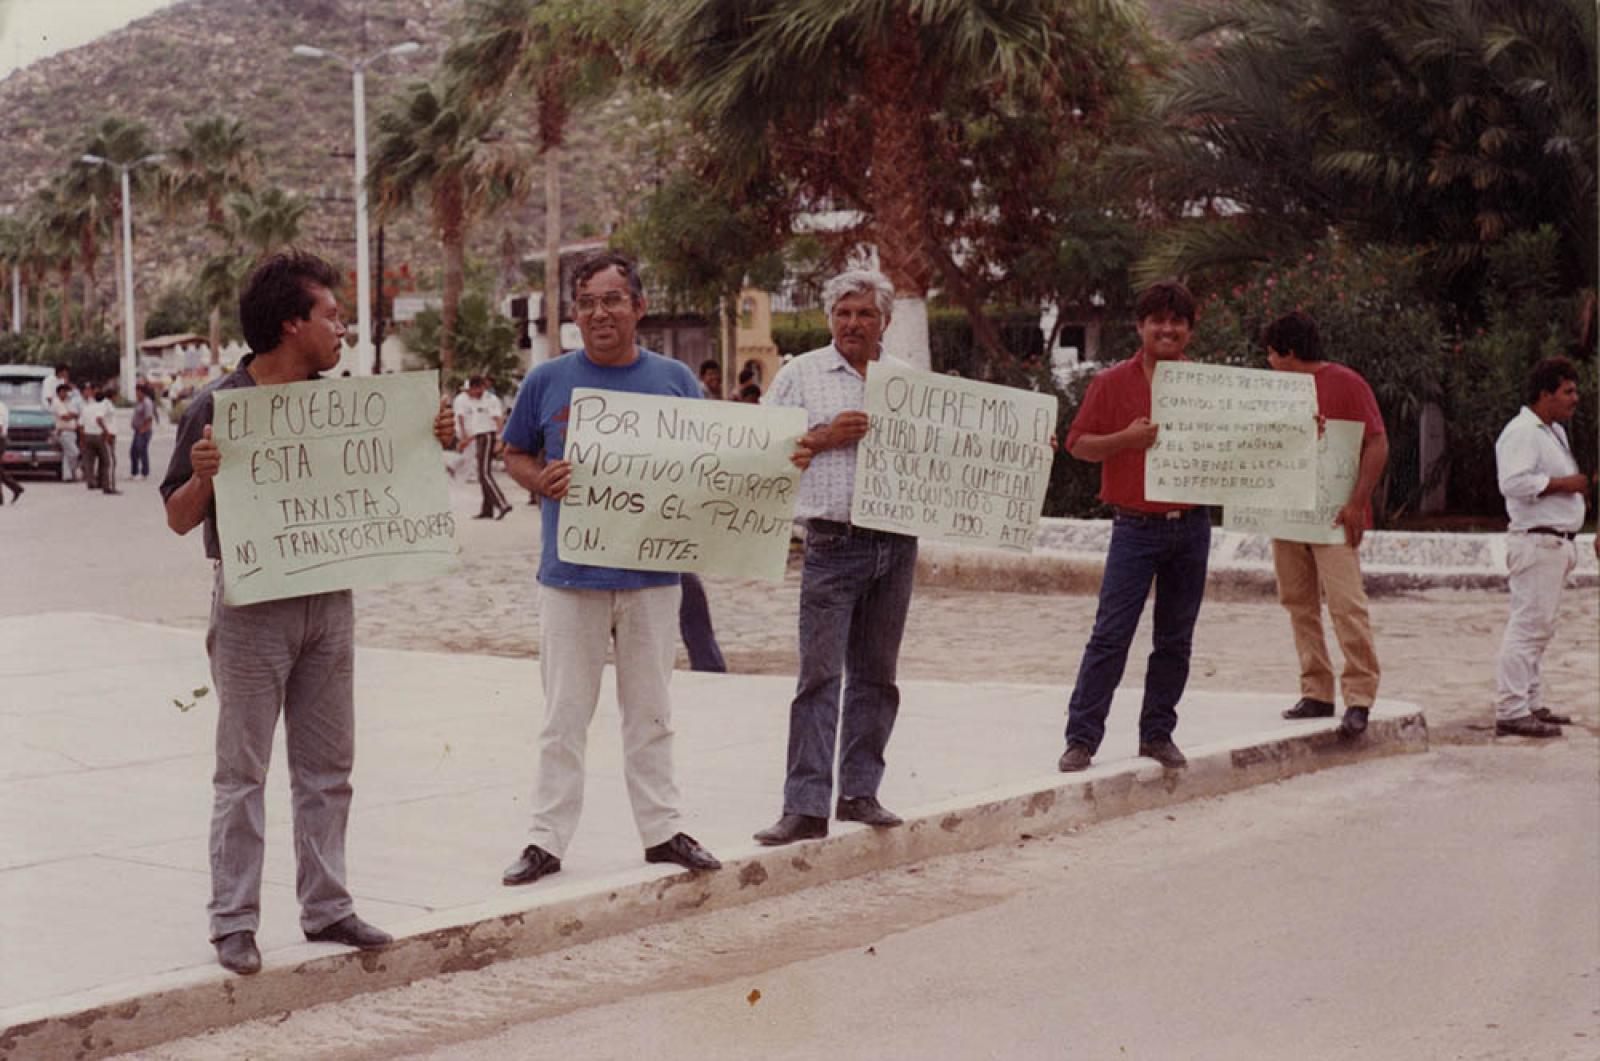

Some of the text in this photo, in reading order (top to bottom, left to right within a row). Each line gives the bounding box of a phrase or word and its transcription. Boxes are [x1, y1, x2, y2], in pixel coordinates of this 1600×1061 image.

[228, 390, 386, 440] EL PUEBLO
[573, 396, 770, 450] POR NINGUN
[885, 376, 1019, 440] QUEREMOS
[867, 414, 917, 453] RETIRO
[924, 427, 942, 453] DE
[952, 431, 982, 459] LAS
[251, 438, 393, 485] ESTA CON
[568, 442, 684, 482] MOTIVO
[865, 450, 887, 473] DES
[929, 459, 949, 482] NO
[962, 464, 1035, 499] CUMPLAN
[1173, 475, 1275, 489] DEFENDERLOS
[279, 486, 400, 525] TAXISTAS
[563, 485, 645, 514] EMOS
[660, 494, 691, 521] EL
[859, 500, 914, 521] DECRETO
[922, 508, 938, 524] DE
[899, 480, 993, 515] REQUISITOS
[1006, 499, 1033, 525] DEL
[236, 511, 455, 564] NO TRANSPORTADORAS
[563, 526, 698, 561] ON. ATTE.
